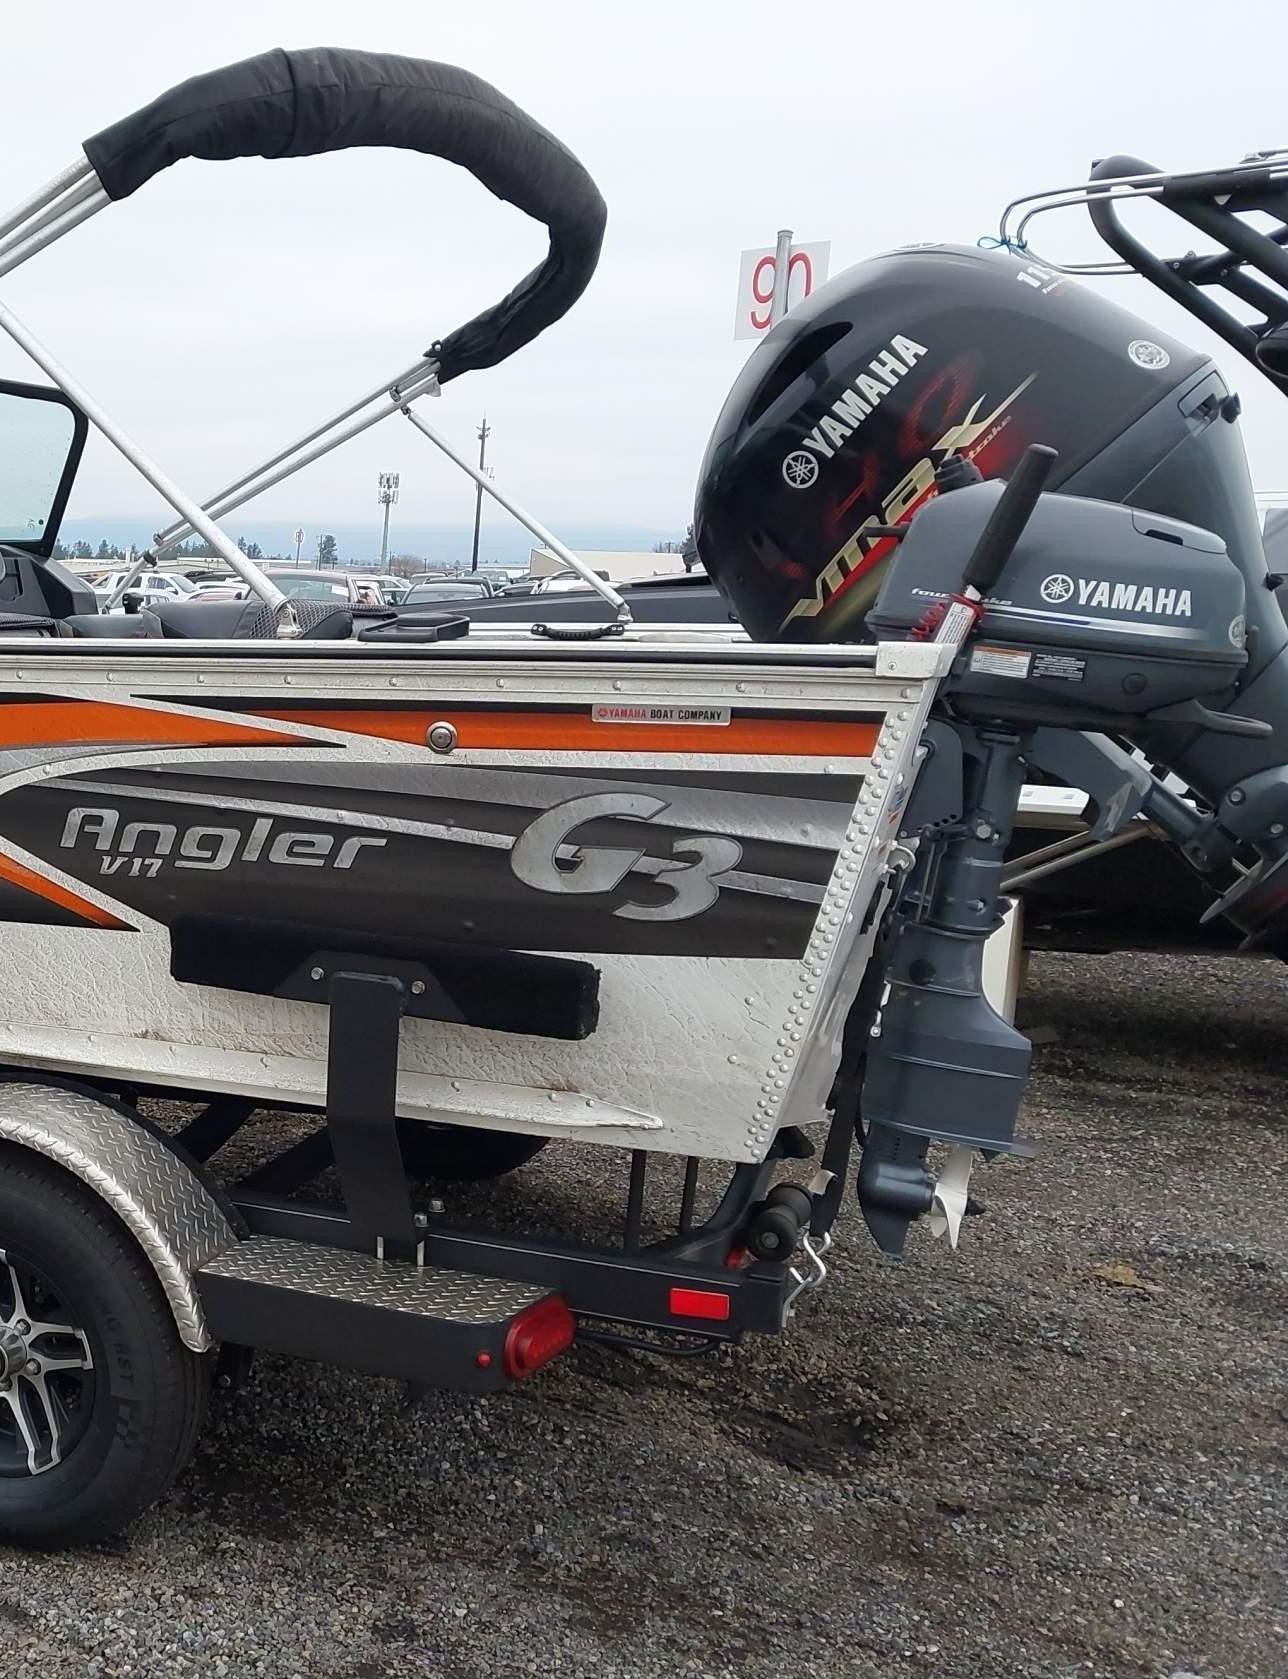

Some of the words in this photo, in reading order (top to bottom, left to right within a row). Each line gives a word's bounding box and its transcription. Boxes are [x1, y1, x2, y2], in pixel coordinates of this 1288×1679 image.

[802, 334, 928, 458] YAMAHA
[1078, 578, 1192, 617] YAMAHA
[608, 708, 647, 719] YAMAHA
[650, 709, 673, 719] BOAT
[678, 710, 722, 720] COMPANY
[60, 807, 388, 870] Angler
[511, 791, 743, 922] G3
